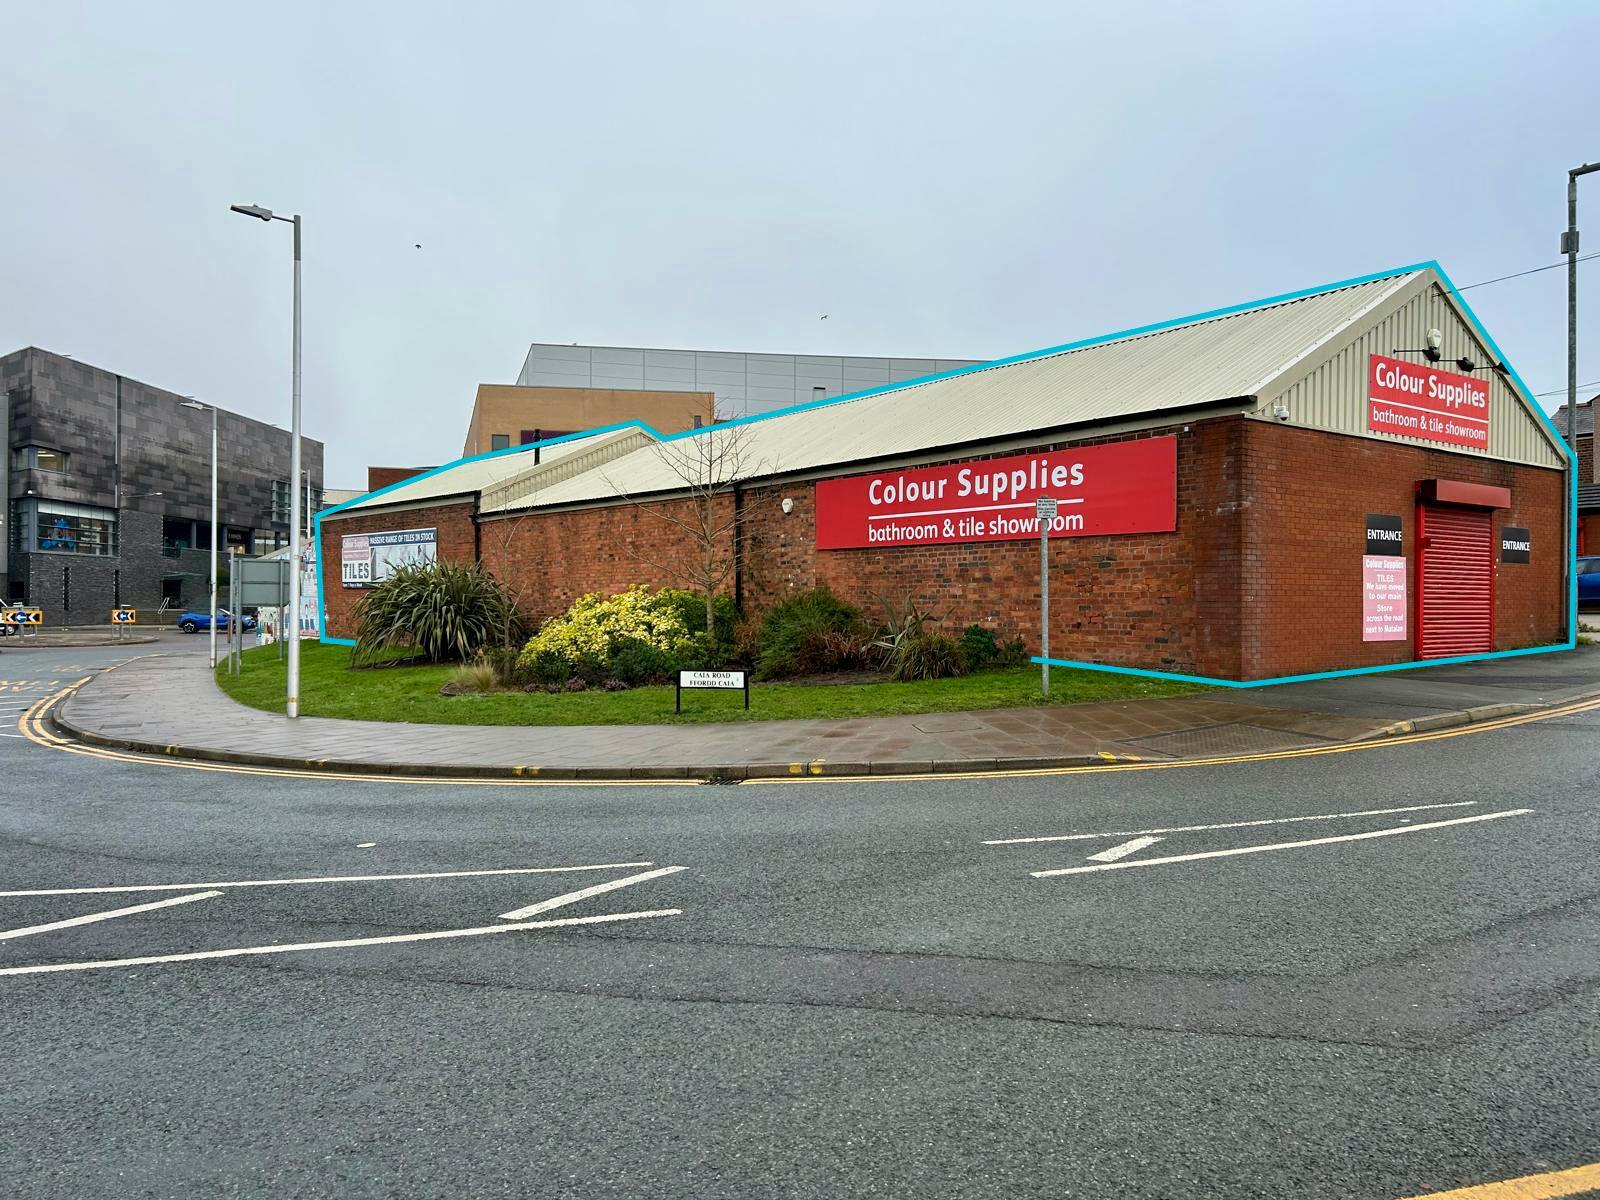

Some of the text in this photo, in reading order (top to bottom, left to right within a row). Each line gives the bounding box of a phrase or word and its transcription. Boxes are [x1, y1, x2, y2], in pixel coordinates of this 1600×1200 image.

[1375, 363, 1485, 408] Colour Supplies
[1373, 406, 1486, 441] bathroom & tile showroom
[869, 459, 1084, 505] Colour Supplies
[868, 522, 938, 542] bathroom
[942, 518, 955, 538] &
[959, 516, 985, 537] tile
[1367, 528, 1402, 541] ENTRANCE
[370, 536, 385, 544] MASSIVE
[385, 535, 398, 543] RANGE
[397, 534, 404, 543] OF
[403, 533, 415, 542] TILES
[421, 532, 434, 541] STOCK
[1502, 540, 1530, 551] ENTRANCE
[343, 562, 369, 579] TILES
[1376, 574, 1395, 583] TILES
[1368, 592, 1376, 600] to
[1387, 592, 1402, 600] main
[1376, 604, 1393, 612] Store
